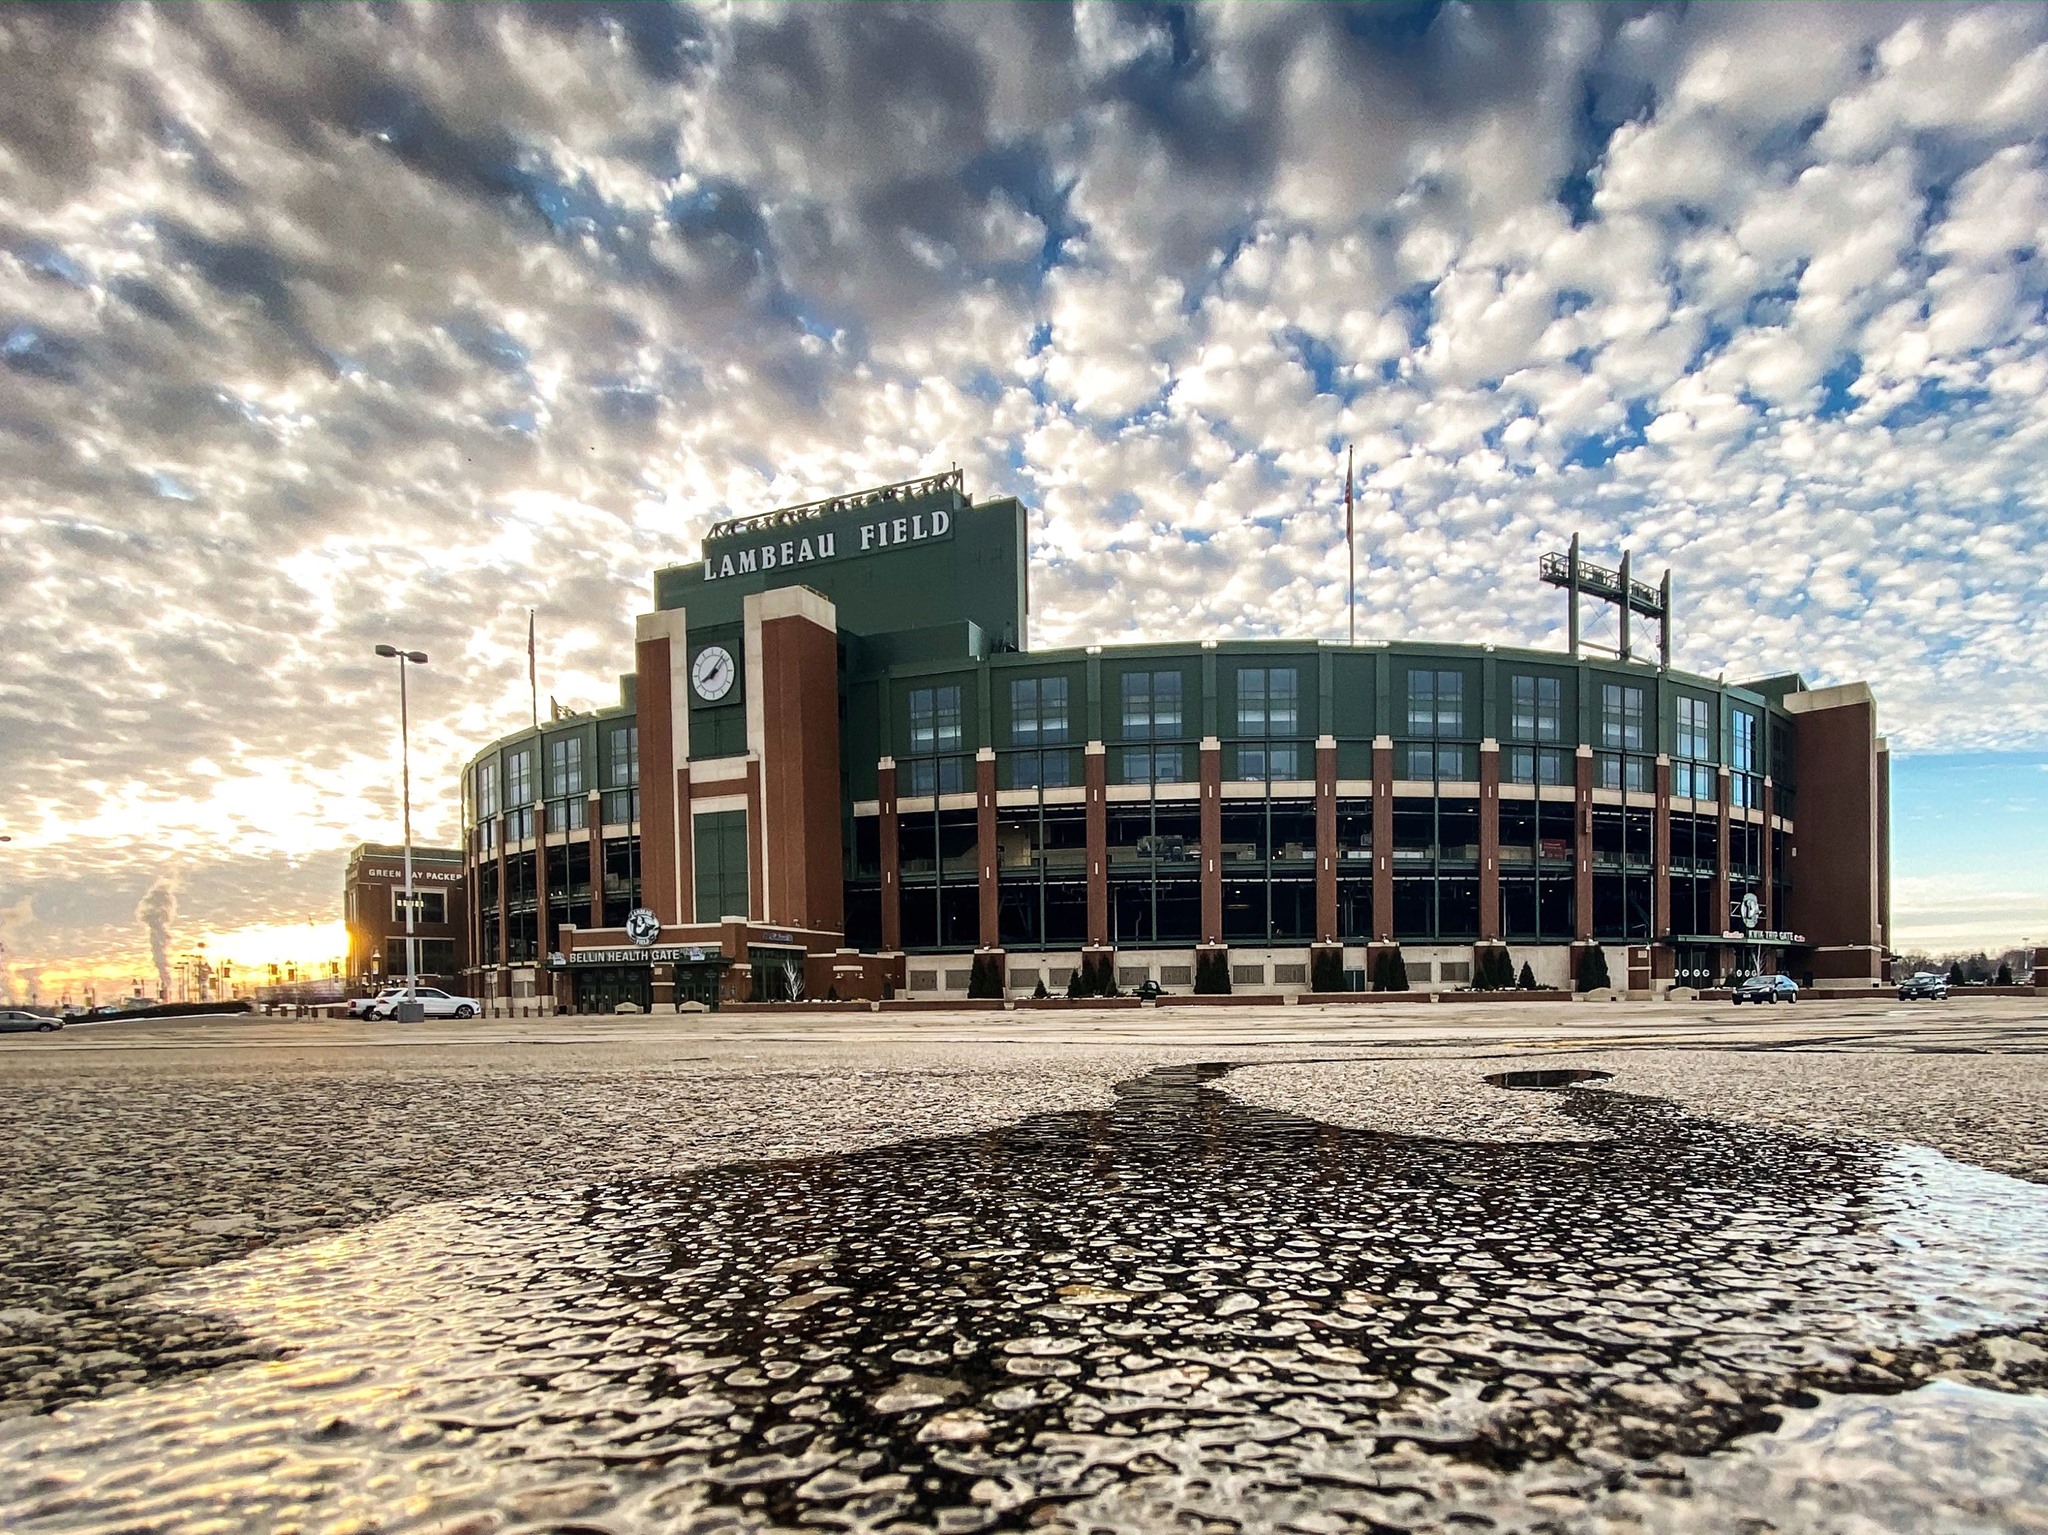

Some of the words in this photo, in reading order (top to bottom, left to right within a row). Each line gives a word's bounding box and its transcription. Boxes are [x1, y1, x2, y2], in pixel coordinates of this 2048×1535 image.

[704, 532, 836, 581] LAMBEAU
[860, 510, 950, 550] FIELD
[368, 868, 402, 878] GREEN
[1779, 931, 1794, 941] GATE
[569, 952, 605, 964] BELLIN
[607, 951, 649, 963] HEALTH
[651, 949, 680, 961] GATE
